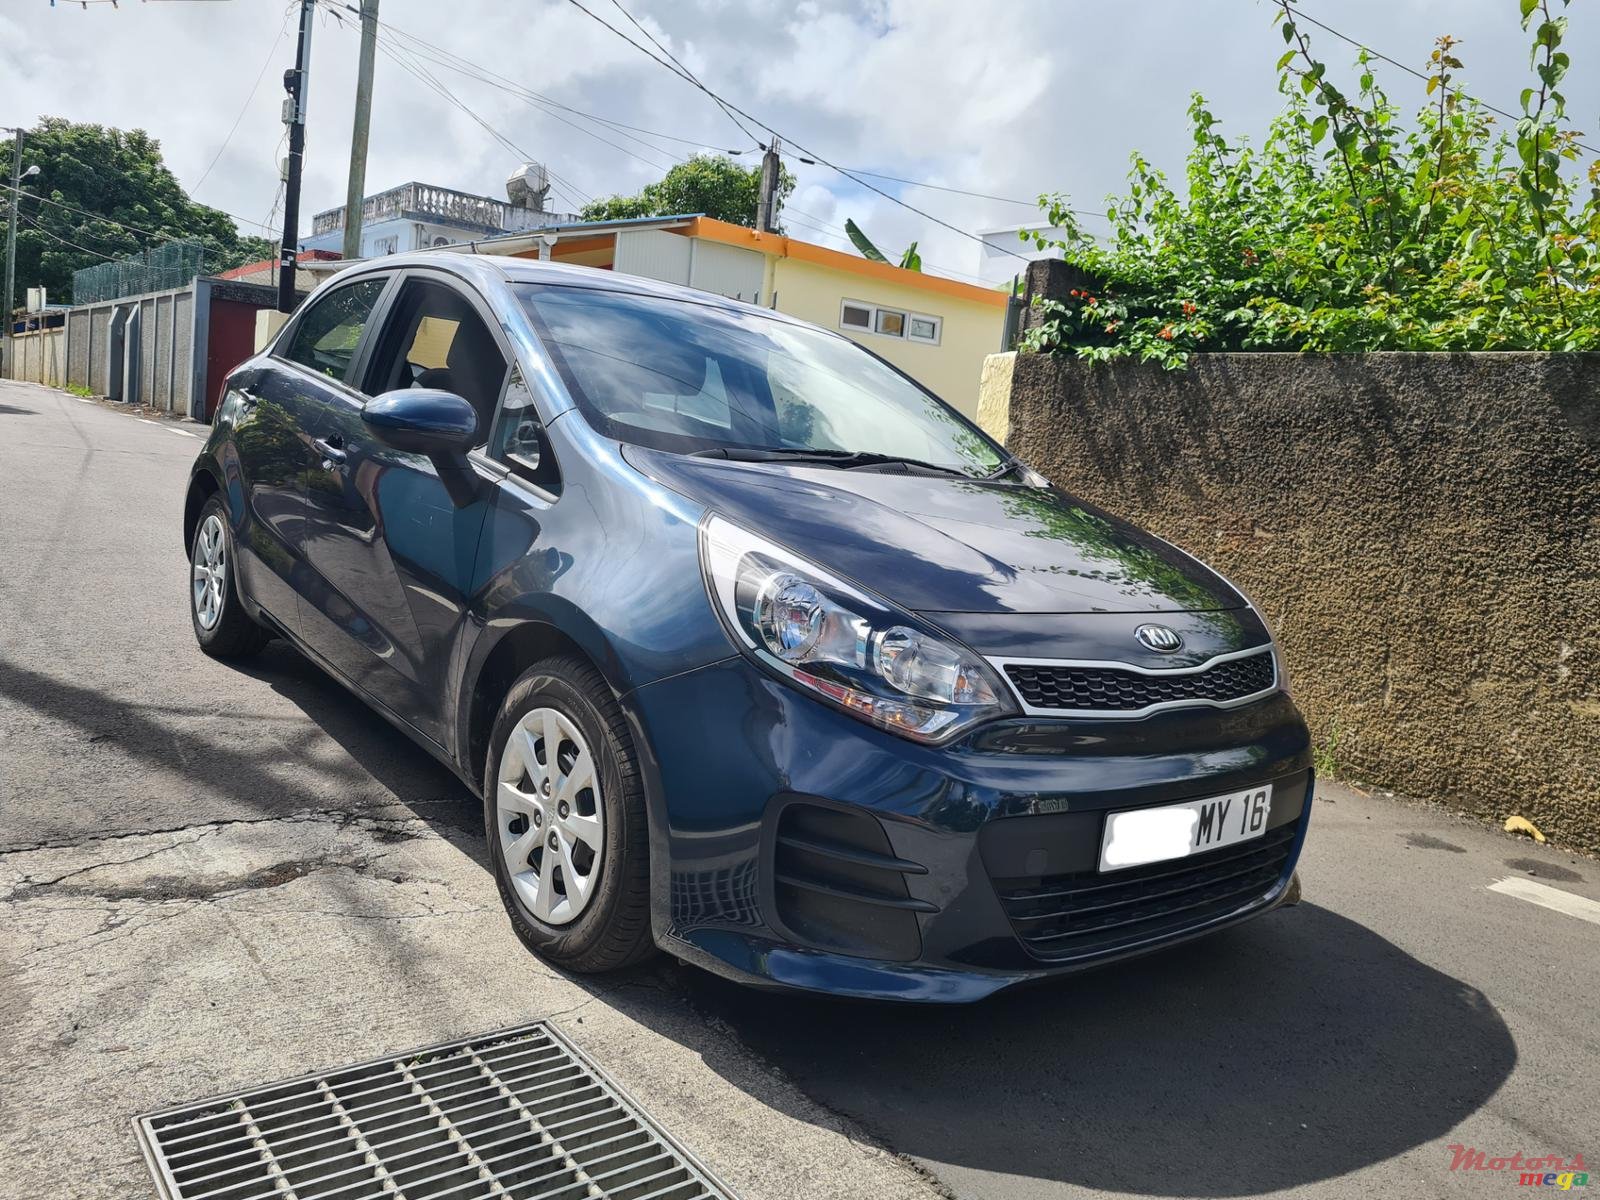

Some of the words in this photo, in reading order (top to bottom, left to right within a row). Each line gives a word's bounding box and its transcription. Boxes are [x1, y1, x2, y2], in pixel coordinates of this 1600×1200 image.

[1139, 626, 1181, 648] KIA
[1196, 799, 1232, 846] MY
[1240, 791, 1267, 835] 16
